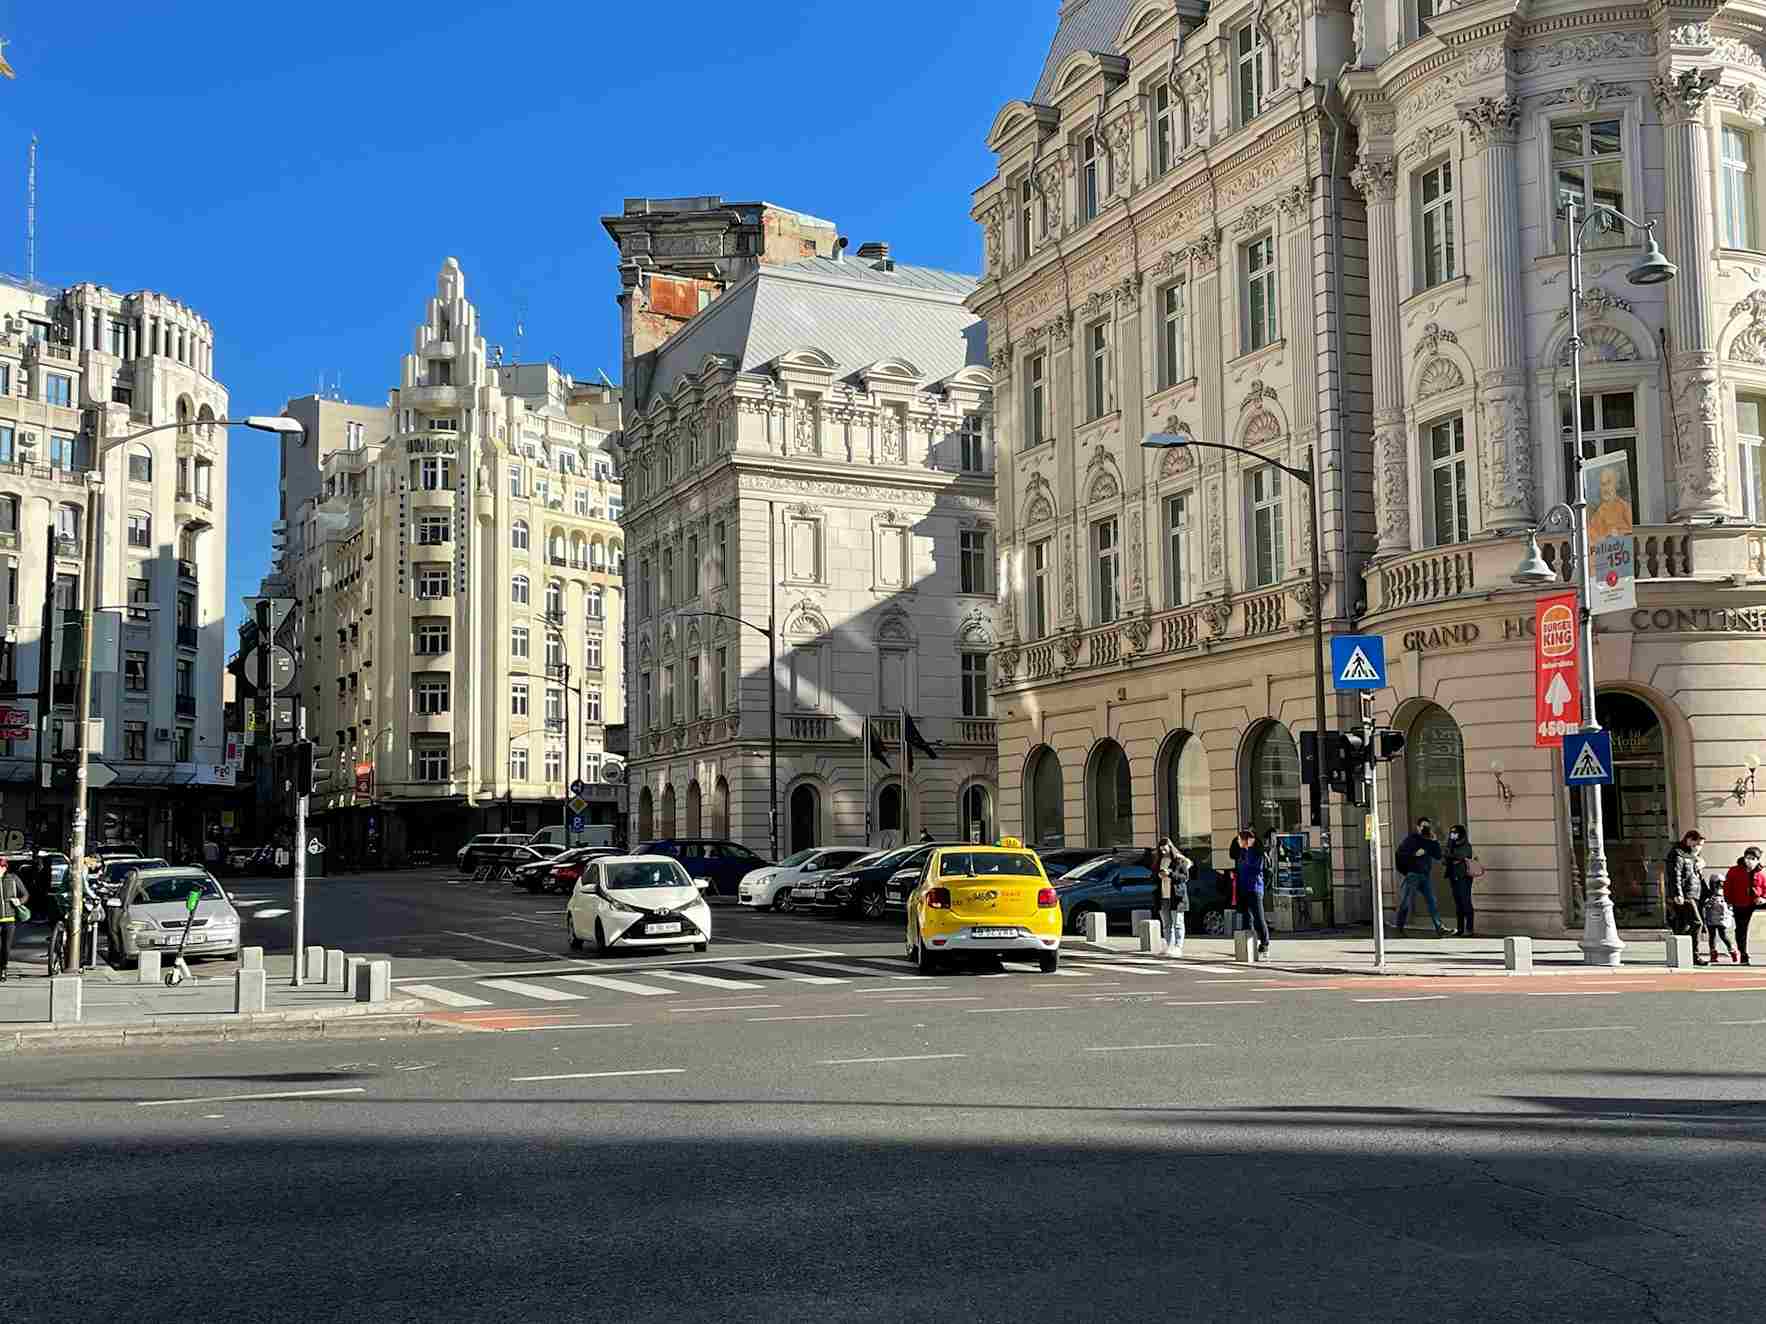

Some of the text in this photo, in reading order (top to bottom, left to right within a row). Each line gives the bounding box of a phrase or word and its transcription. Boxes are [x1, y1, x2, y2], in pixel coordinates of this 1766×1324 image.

[1607, 550, 1631, 568] 150
[1543, 620, 1572, 632] BURGER
[1403, 623, 1480, 651] GRAND
[1543, 630, 1572, 647] KING
[1538, 720, 1579, 736] 450m
